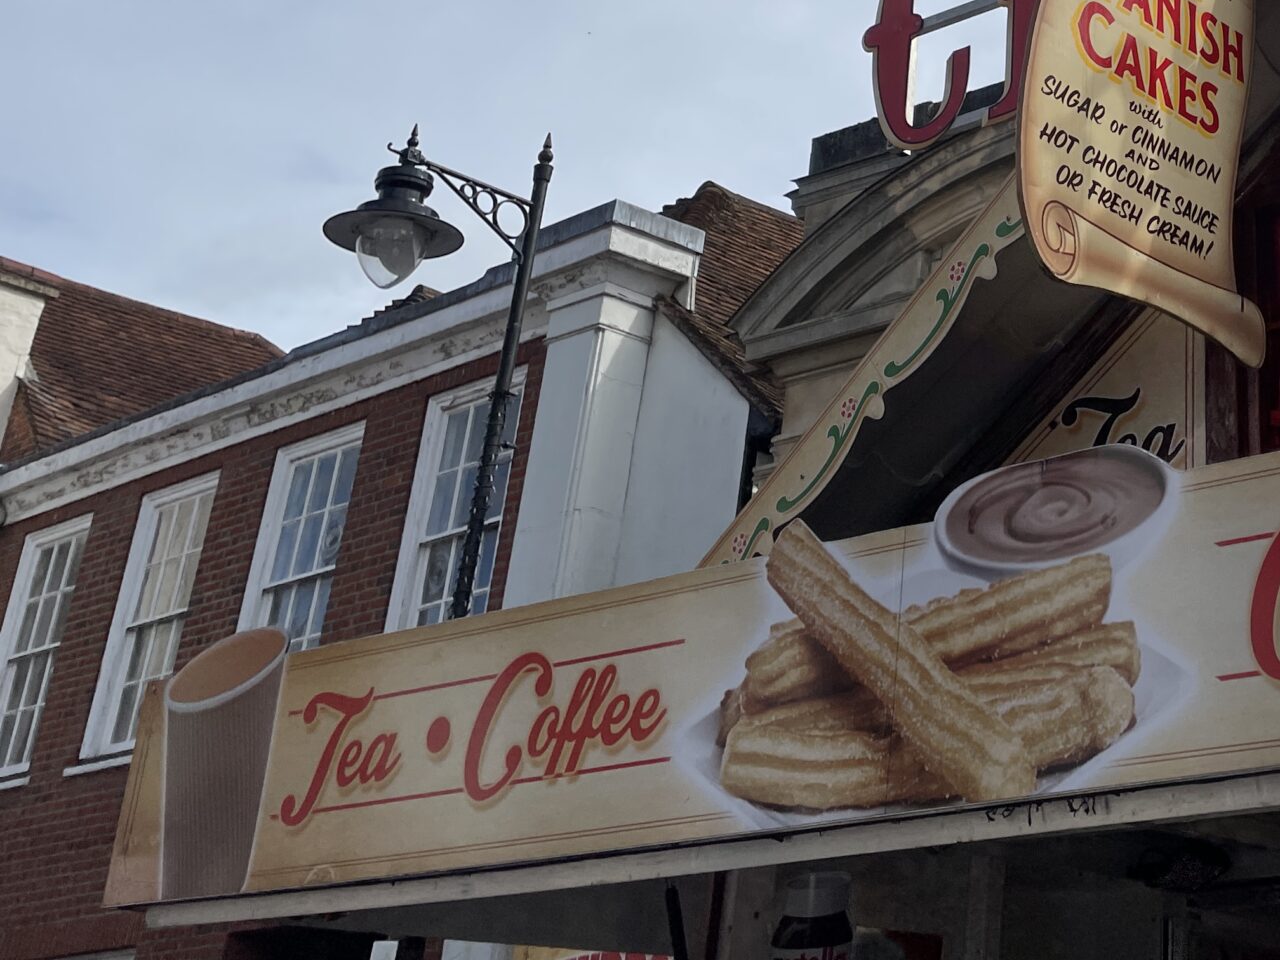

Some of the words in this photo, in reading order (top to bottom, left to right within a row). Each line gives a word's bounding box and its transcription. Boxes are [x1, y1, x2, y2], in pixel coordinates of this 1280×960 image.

[1076, 0, 1220, 135] CAKES
[1129, 101, 1163, 129] with
[1039, 122, 1080, 155] HOT
[1082, 145, 1171, 209] CHOCOLATE
[1172, 196, 1220, 234] SAUCE
[1041, 75, 1106, 125] SUGAR
[1110, 119, 1128, 136] or
[1132, 126, 1222, 184] CINNAMON
[1125, 149, 1160, 171] AND
[1056, 164, 1084, 193] OR
[1087, 179, 1144, 226] FRESH
[1146, 215, 1215, 260] CREAM!
[281, 686, 402, 826] Tea
[464, 652, 667, 801] Coffee
